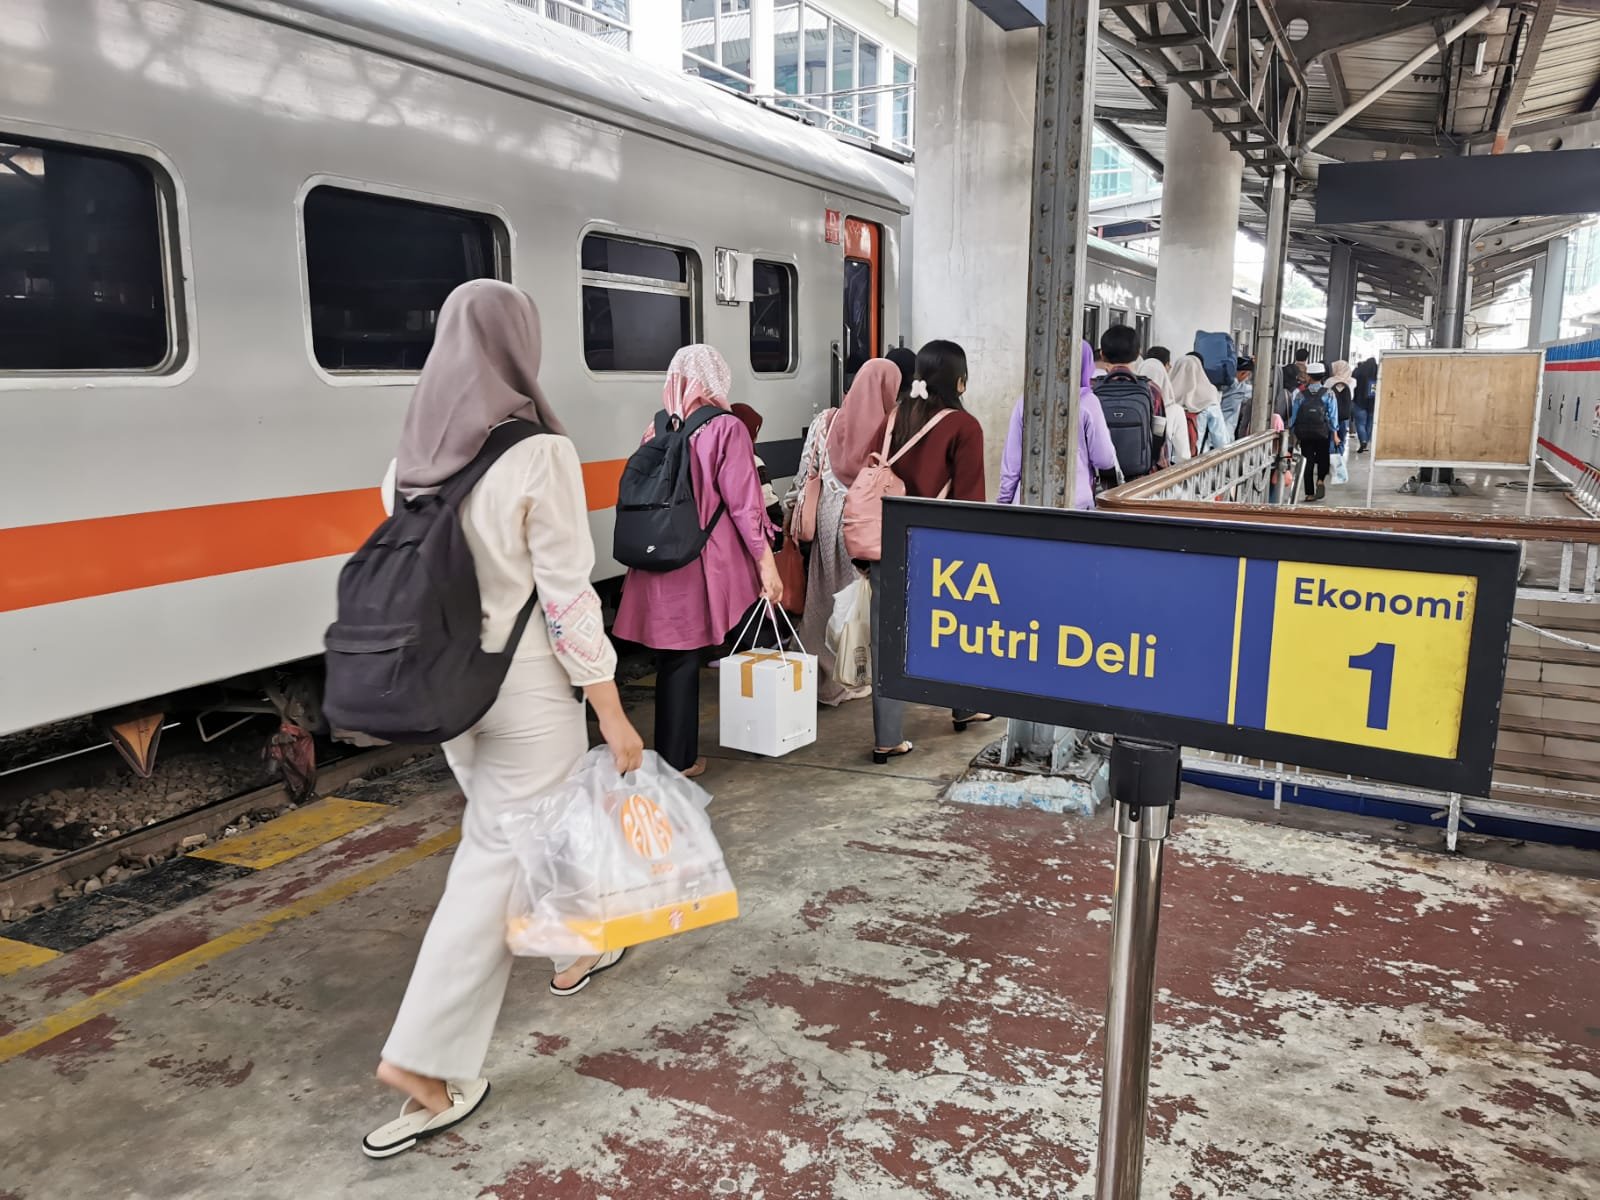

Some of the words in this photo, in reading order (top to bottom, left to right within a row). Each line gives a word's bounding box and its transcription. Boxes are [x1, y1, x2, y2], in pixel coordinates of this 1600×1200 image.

[931, 558, 1000, 606] KA
[1294, 577, 1466, 621] Ekonomi
[930, 610, 1039, 662] Putri
[1057, 625, 1158, 678] Deli
[1348, 643, 1396, 731] 1
